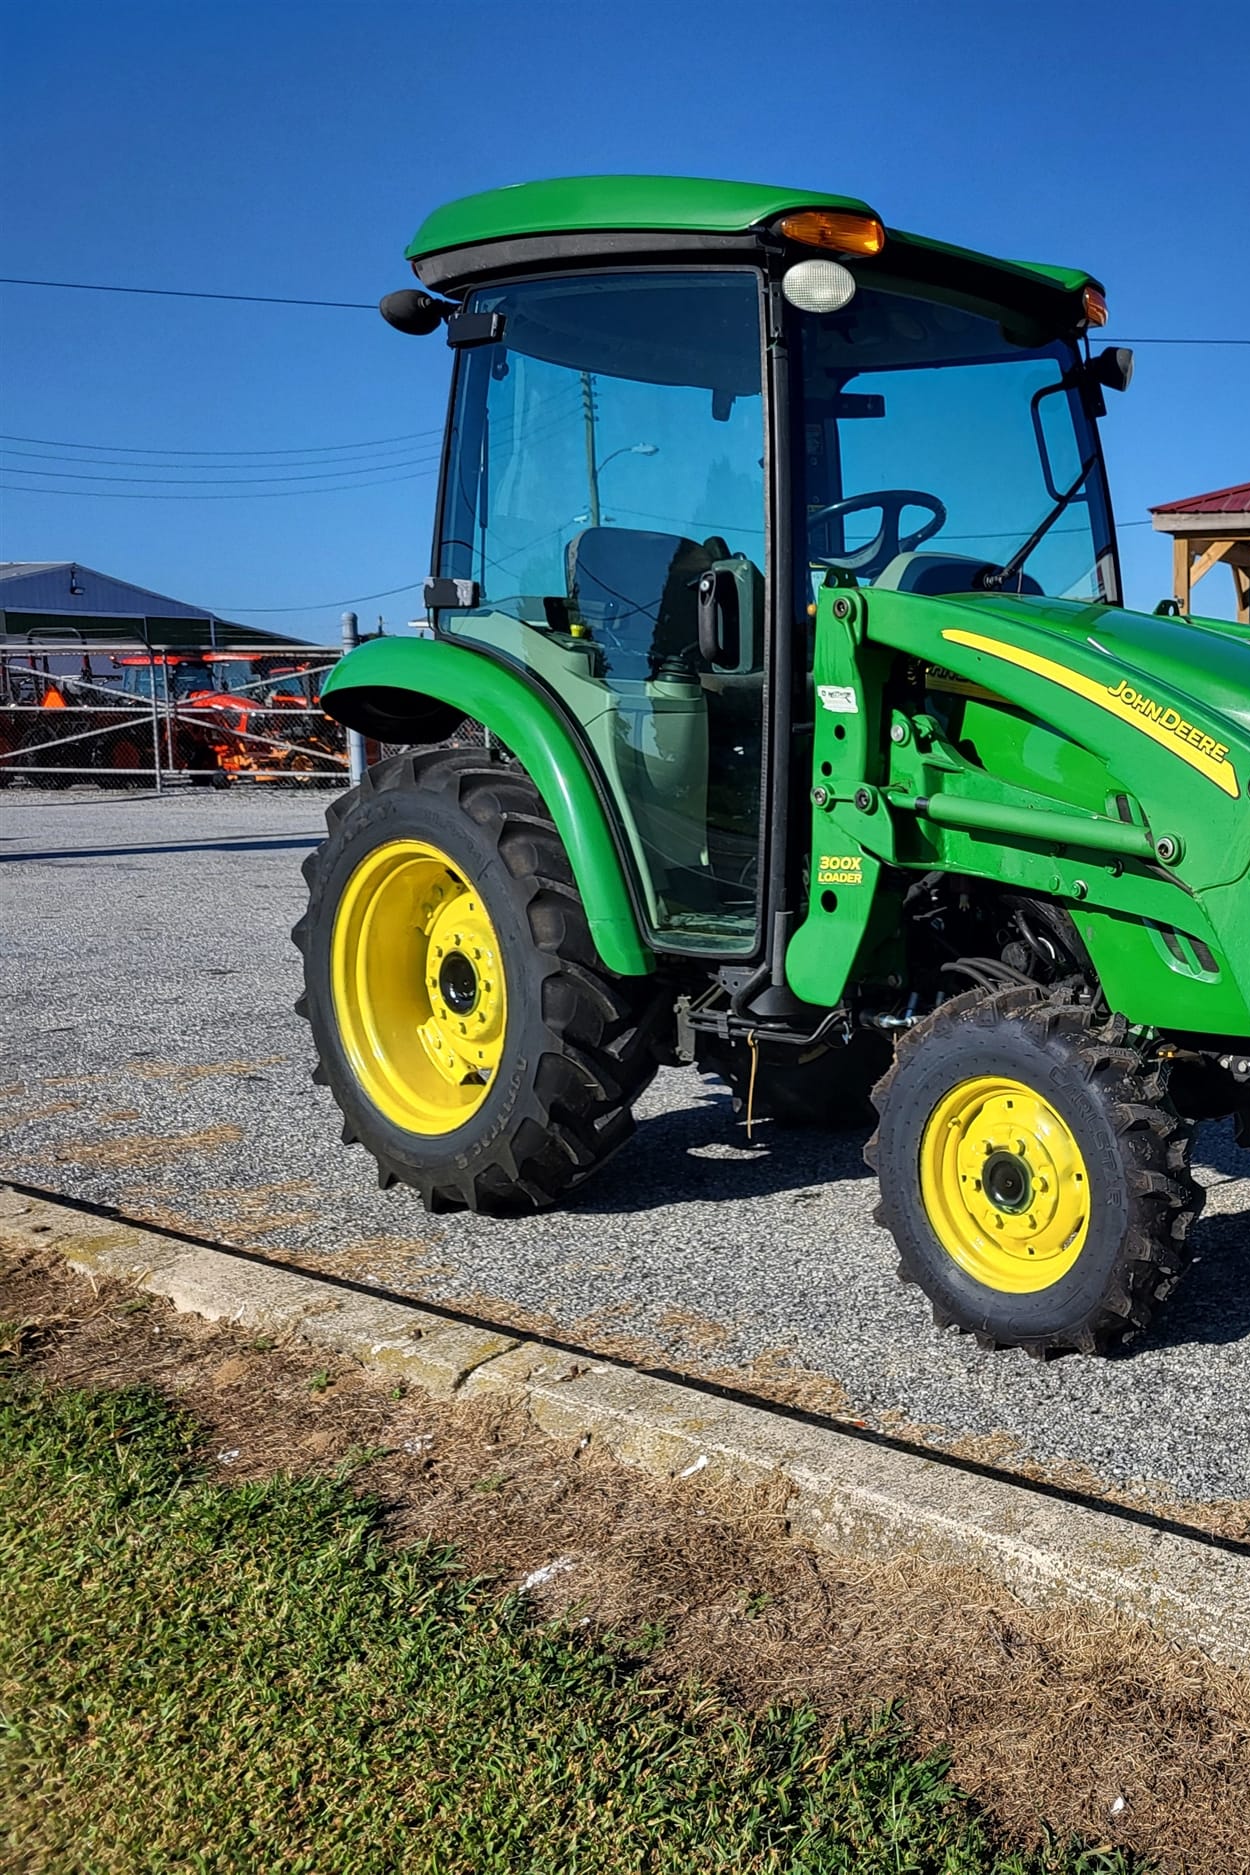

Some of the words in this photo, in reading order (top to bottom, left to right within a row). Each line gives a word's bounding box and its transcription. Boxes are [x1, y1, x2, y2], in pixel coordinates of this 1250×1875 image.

[1107, 680, 1163, 722] JOHN
[1159, 706, 1230, 764] DEERE
[820, 855, 862, 870] 300X
[818, 871, 862, 884] LOADER
